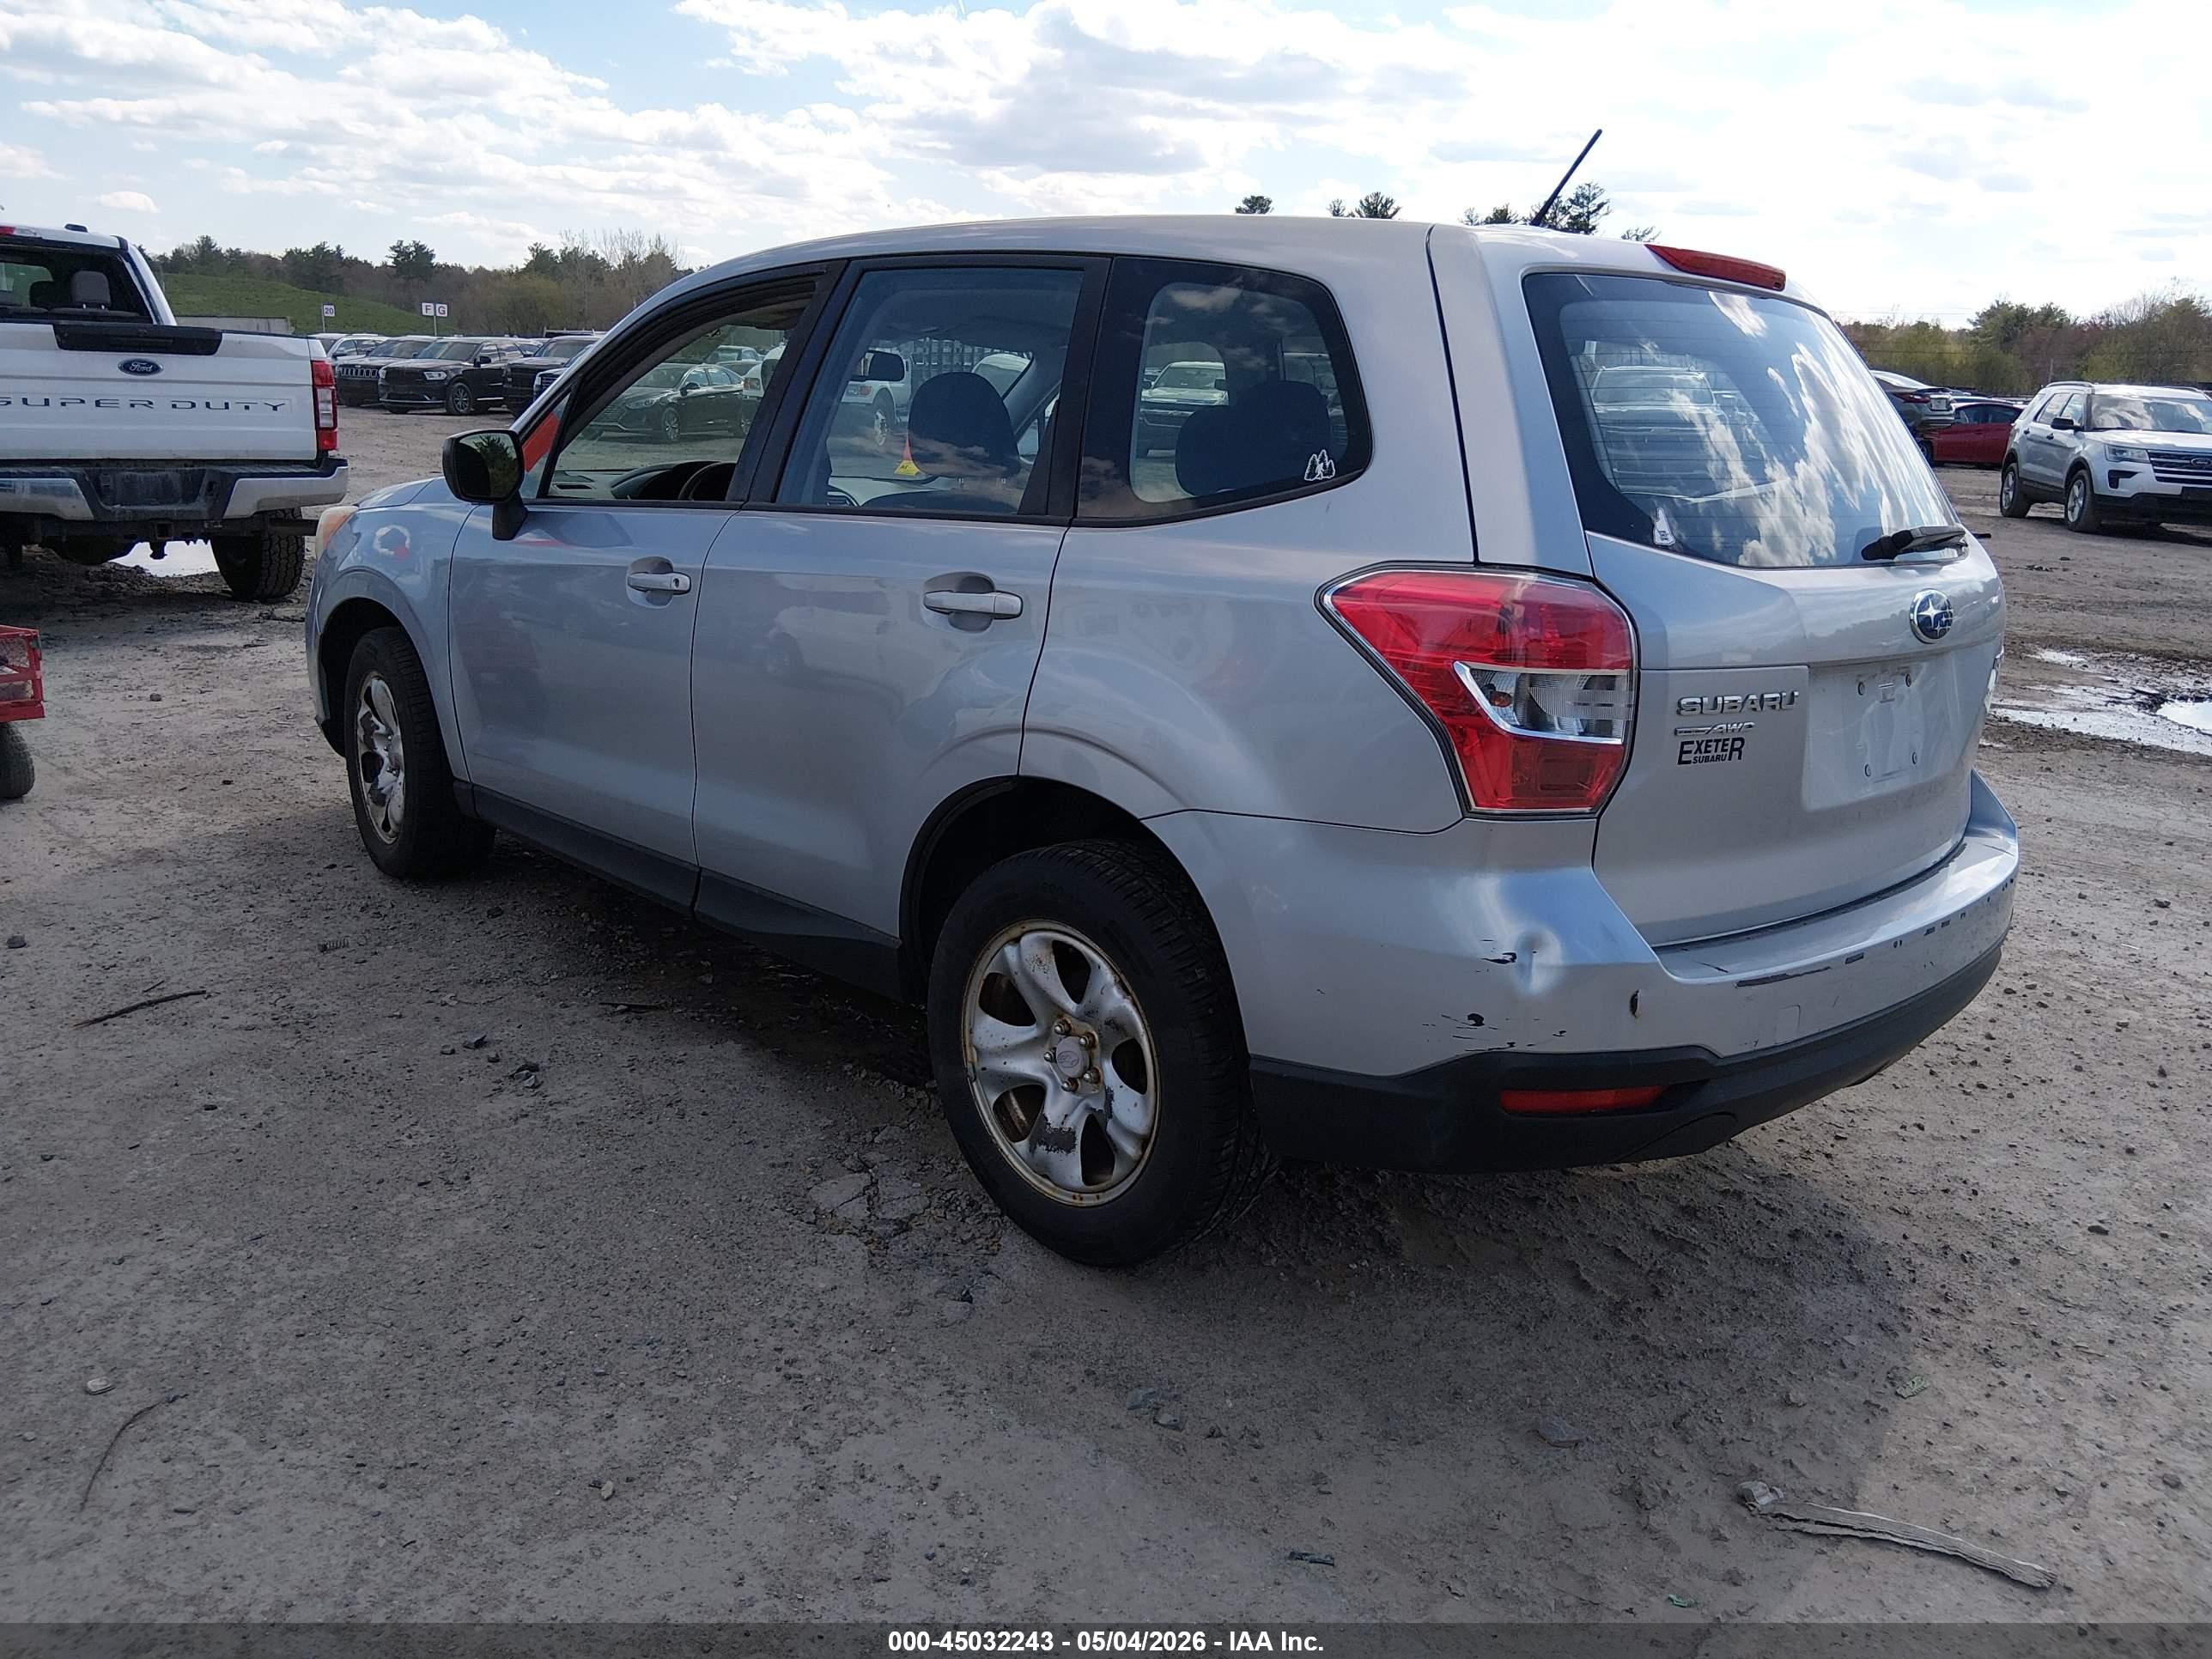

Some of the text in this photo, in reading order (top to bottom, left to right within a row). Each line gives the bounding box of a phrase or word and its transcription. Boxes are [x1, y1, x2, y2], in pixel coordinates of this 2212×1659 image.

[425, 305, 446, 314] F G
[129, 362, 153, 373] Ford
[171, 400, 288, 411] DUTY
[1677, 690, 1799, 715] SUBARU
[1677, 736, 1746, 765] EXETER
[1692, 754, 1729, 764] SUBARU
